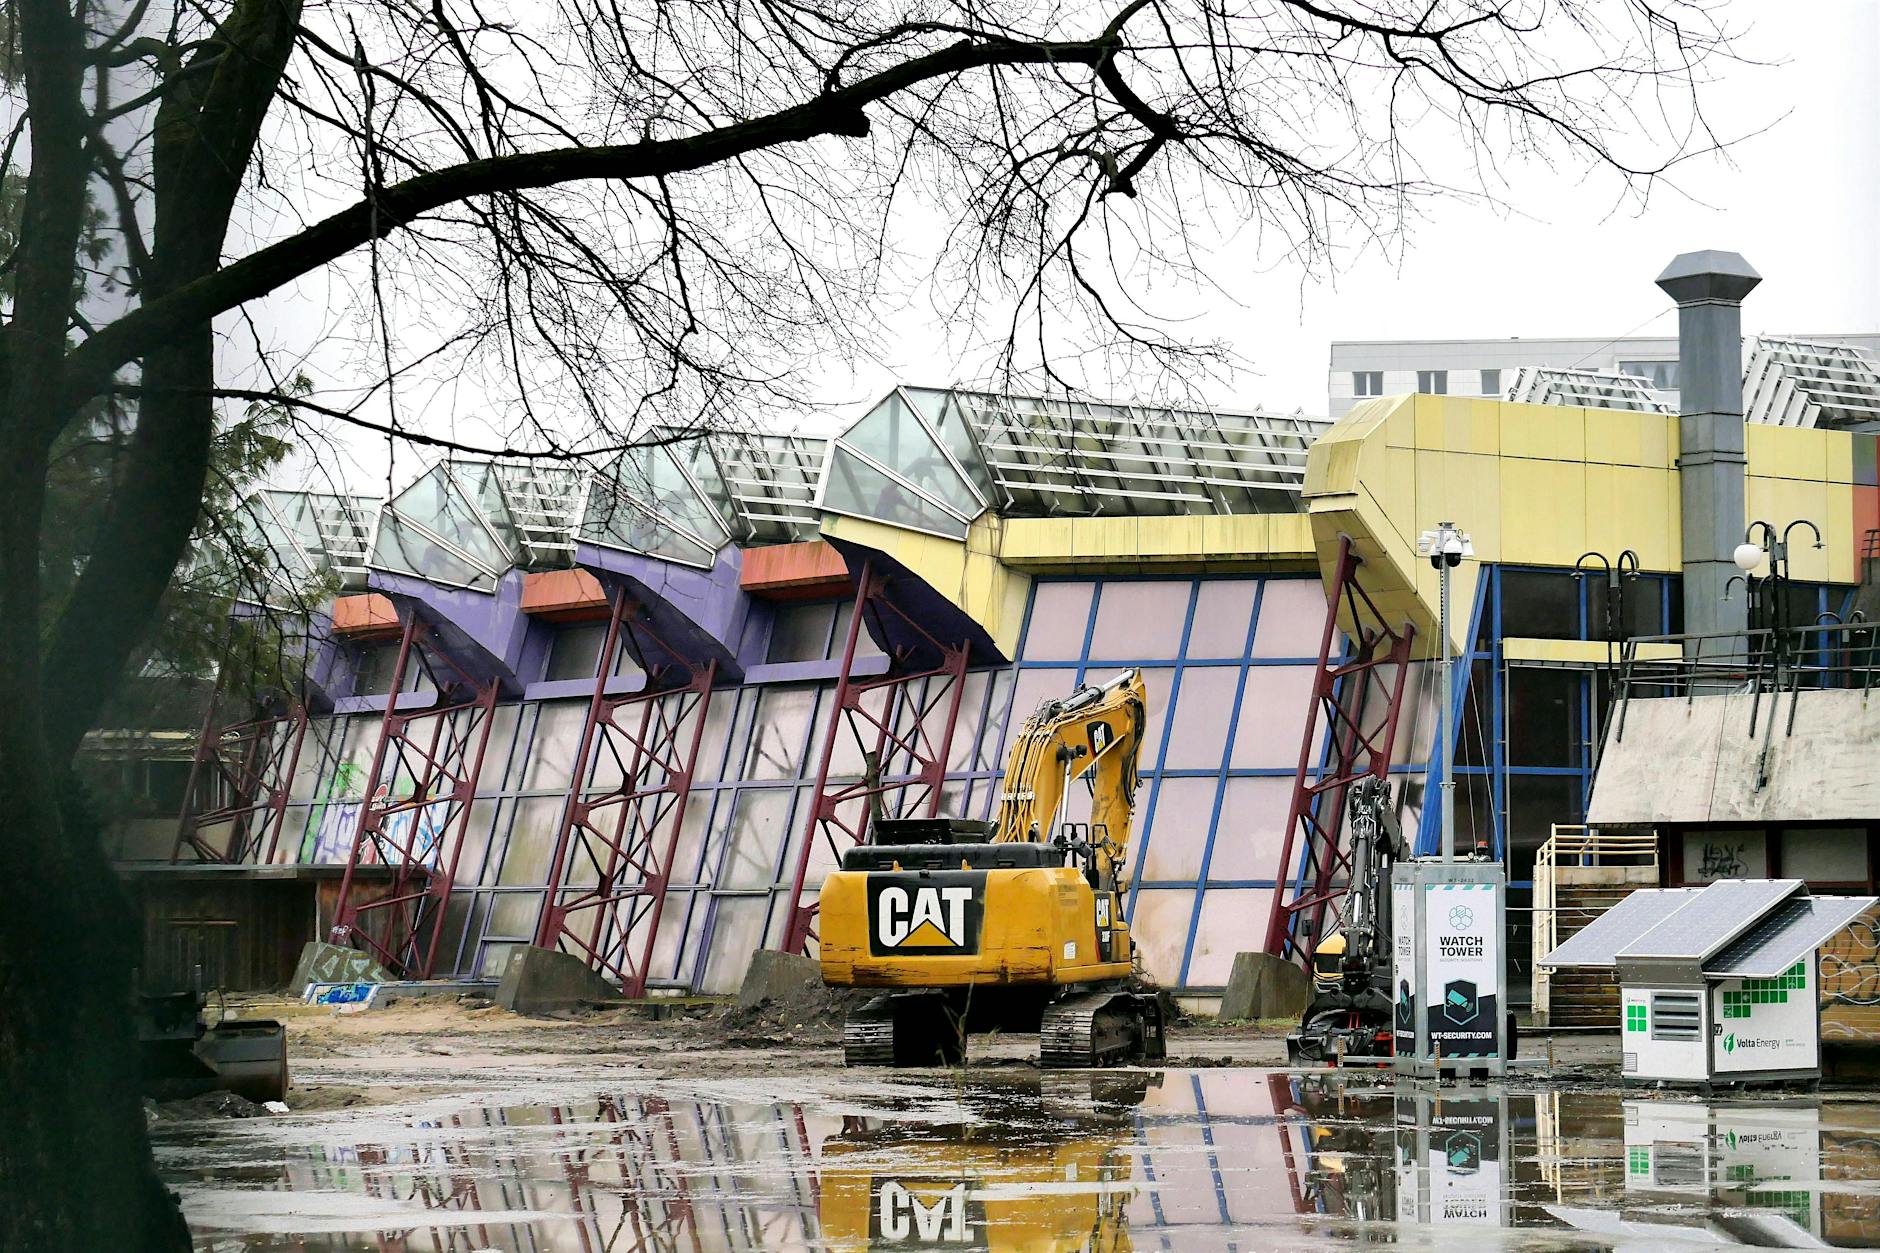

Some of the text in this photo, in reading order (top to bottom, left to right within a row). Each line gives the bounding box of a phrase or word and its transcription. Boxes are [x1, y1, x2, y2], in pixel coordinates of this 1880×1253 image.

[879, 887, 972, 947] CAT
[1096, 898, 1110, 927] CAT
[1439, 936, 1483, 946] WATCH
[1439, 947, 1483, 957] TOWER
[1431, 1031, 1492, 1040] WT-SECURITY.COM
[1736, 1039, 1756, 1048] Volta
[1756, 1038, 1780, 1050] Energy
